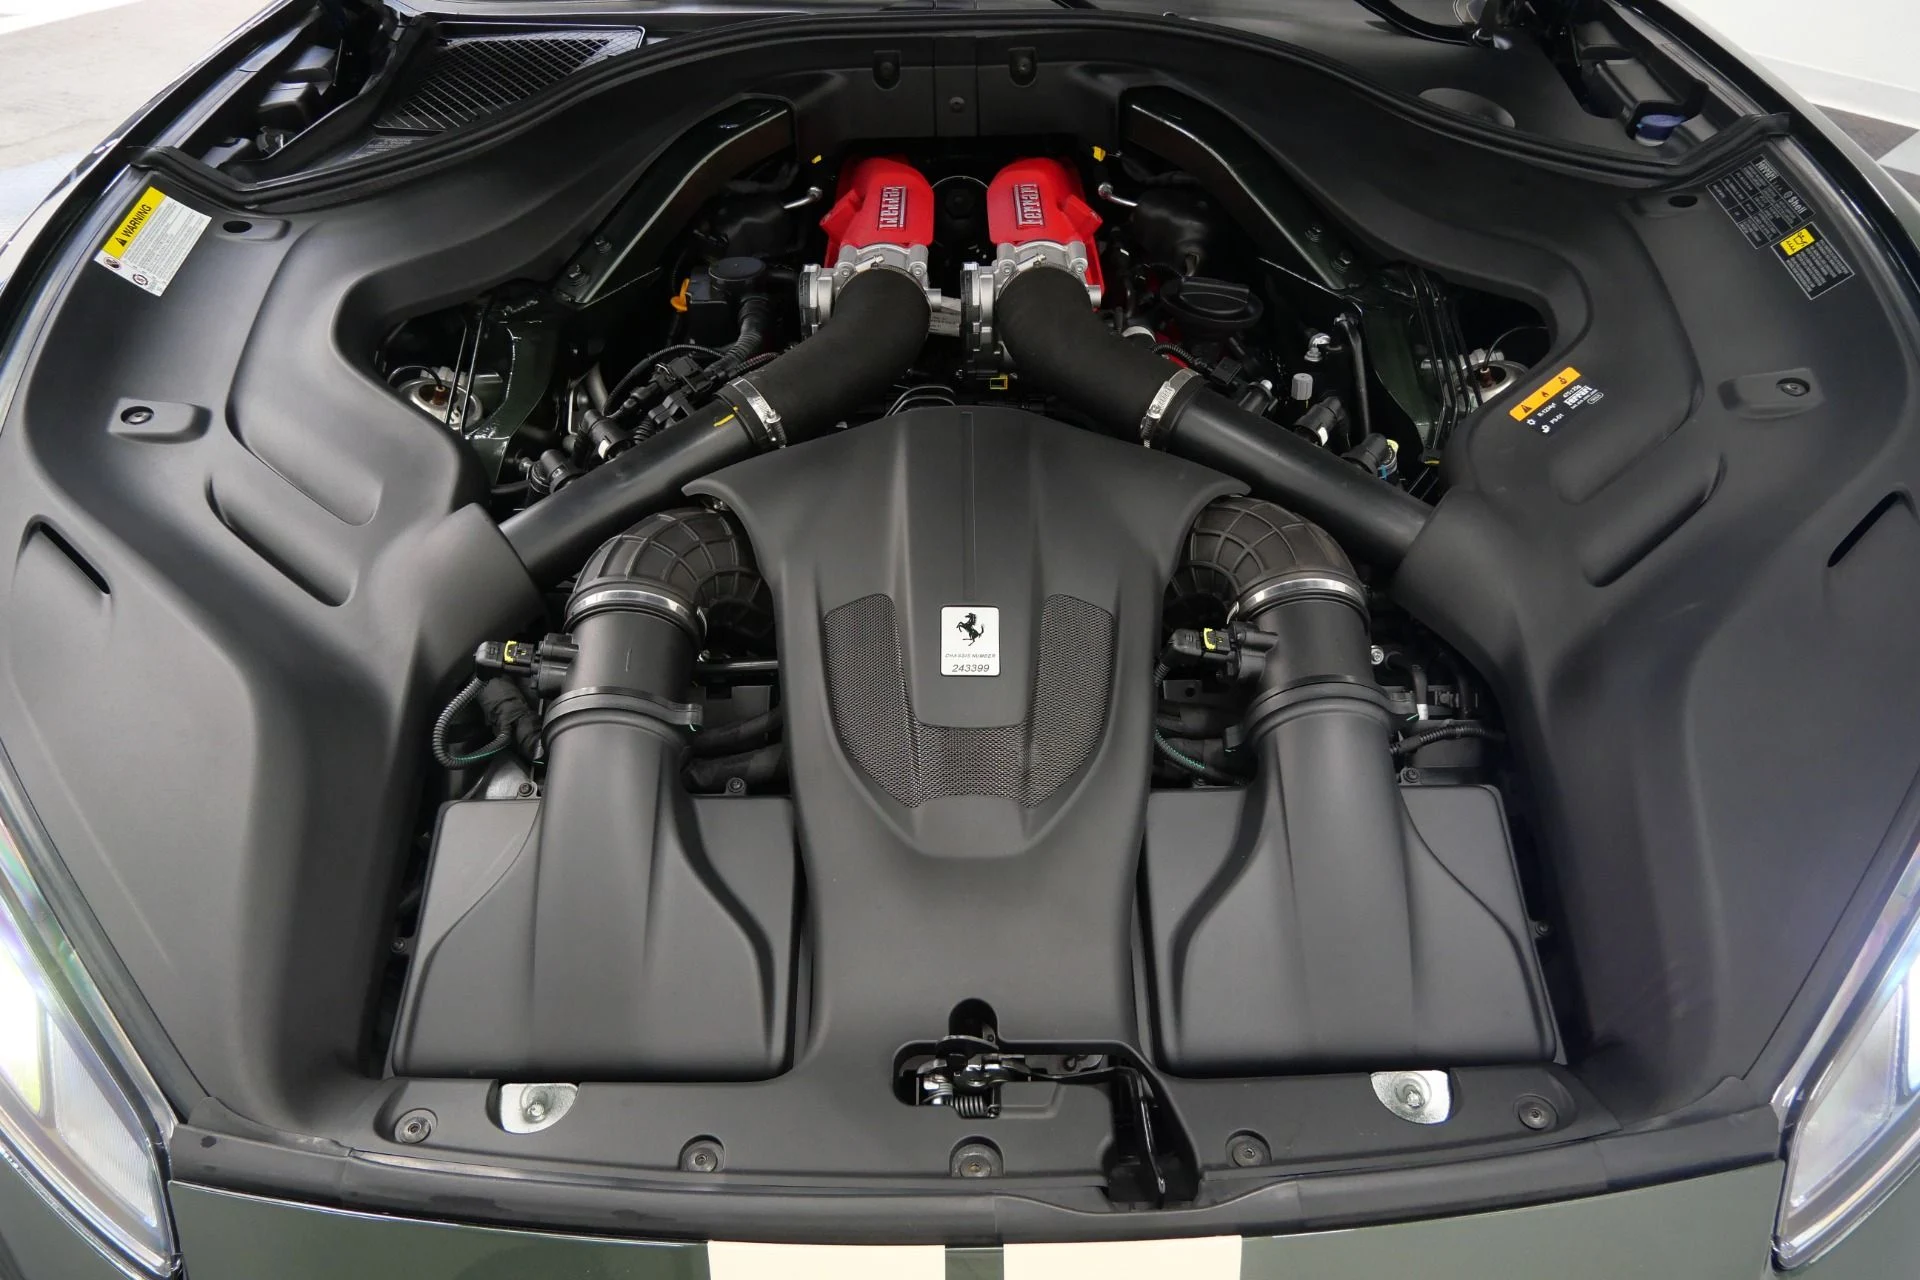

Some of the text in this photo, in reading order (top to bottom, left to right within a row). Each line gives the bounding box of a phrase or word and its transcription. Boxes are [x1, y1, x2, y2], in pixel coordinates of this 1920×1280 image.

[879, 186, 906, 229] Ferrari
[1014, 183, 1044, 226] Ferrari
[1788, 196, 1808, 214] Shell
[122, 204, 152, 238] WARNING
[1563, 385, 1593, 406] Ferrari
[952, 664, 990, 673] 243399
